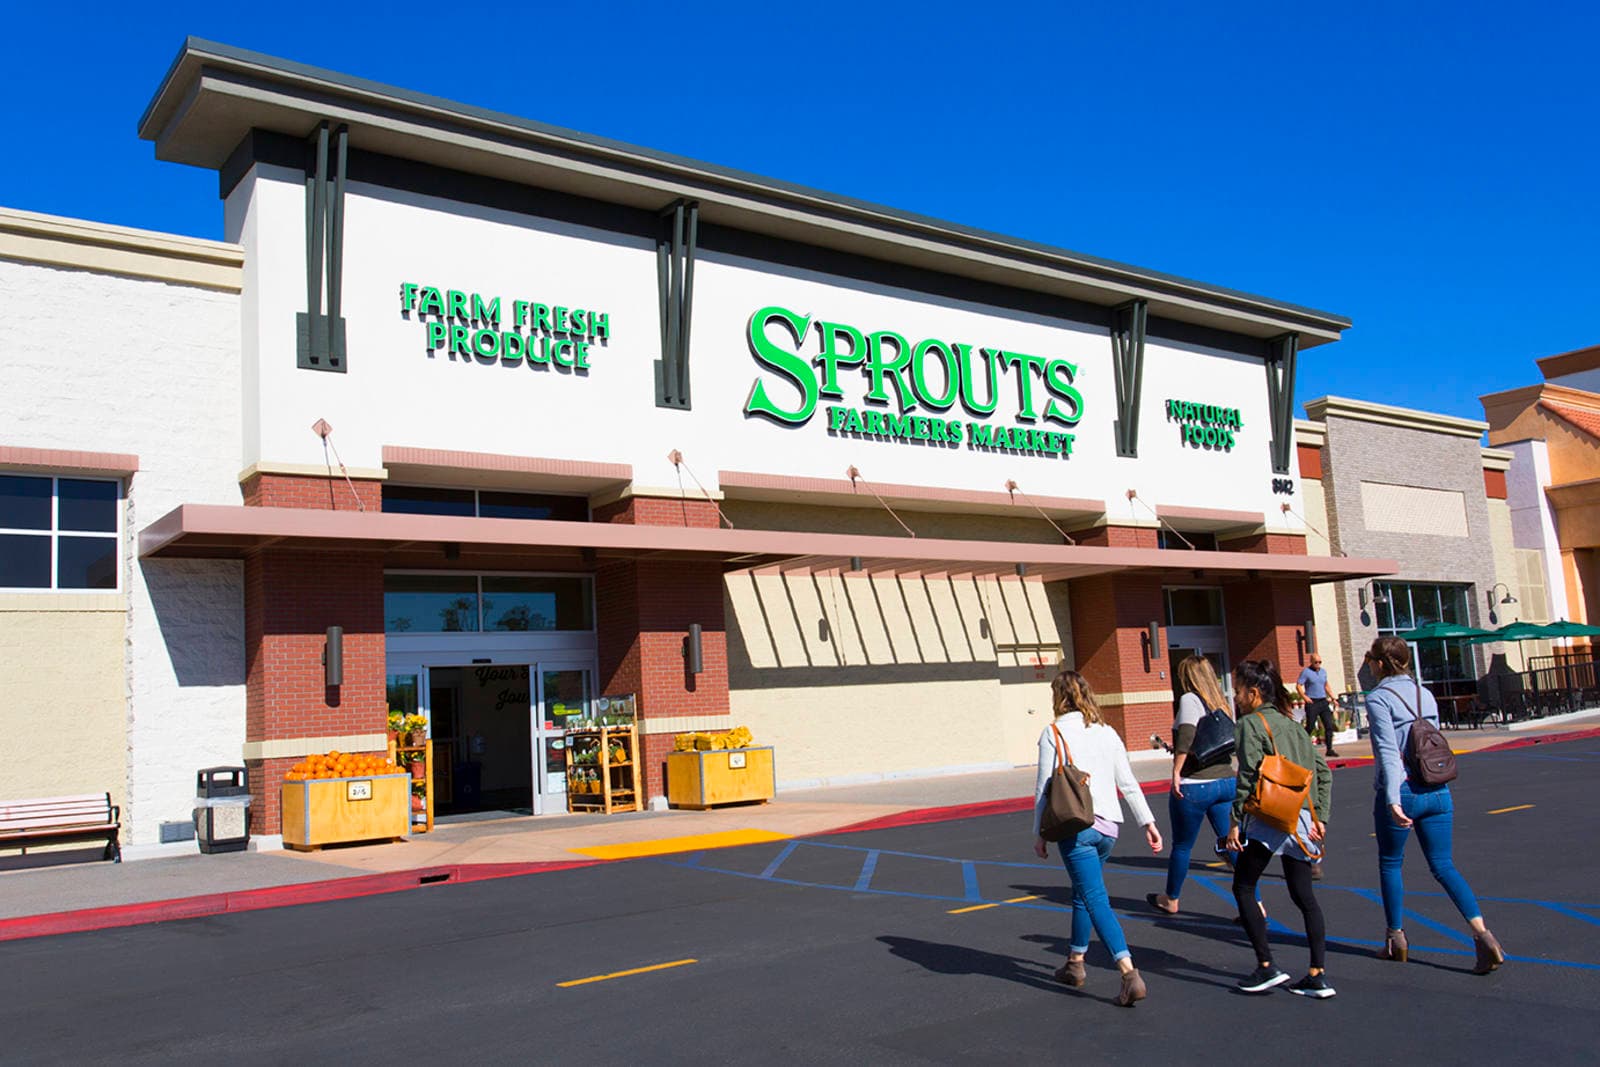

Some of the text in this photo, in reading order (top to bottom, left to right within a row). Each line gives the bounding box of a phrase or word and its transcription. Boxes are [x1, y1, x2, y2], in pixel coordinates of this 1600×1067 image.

[402, 282, 610, 340] FARM FRESH
[428, 321, 592, 371] PRODUCE
[745, 305, 1085, 426] SPROUTS
[829, 405, 1076, 456] FARMERS MARKET
[1167, 399, 1245, 430] NATURAL
[1182, 421, 1236, 450] FOODS
[474, 665, 516, 687] Your
[496, 688, 530, 710] Jou
